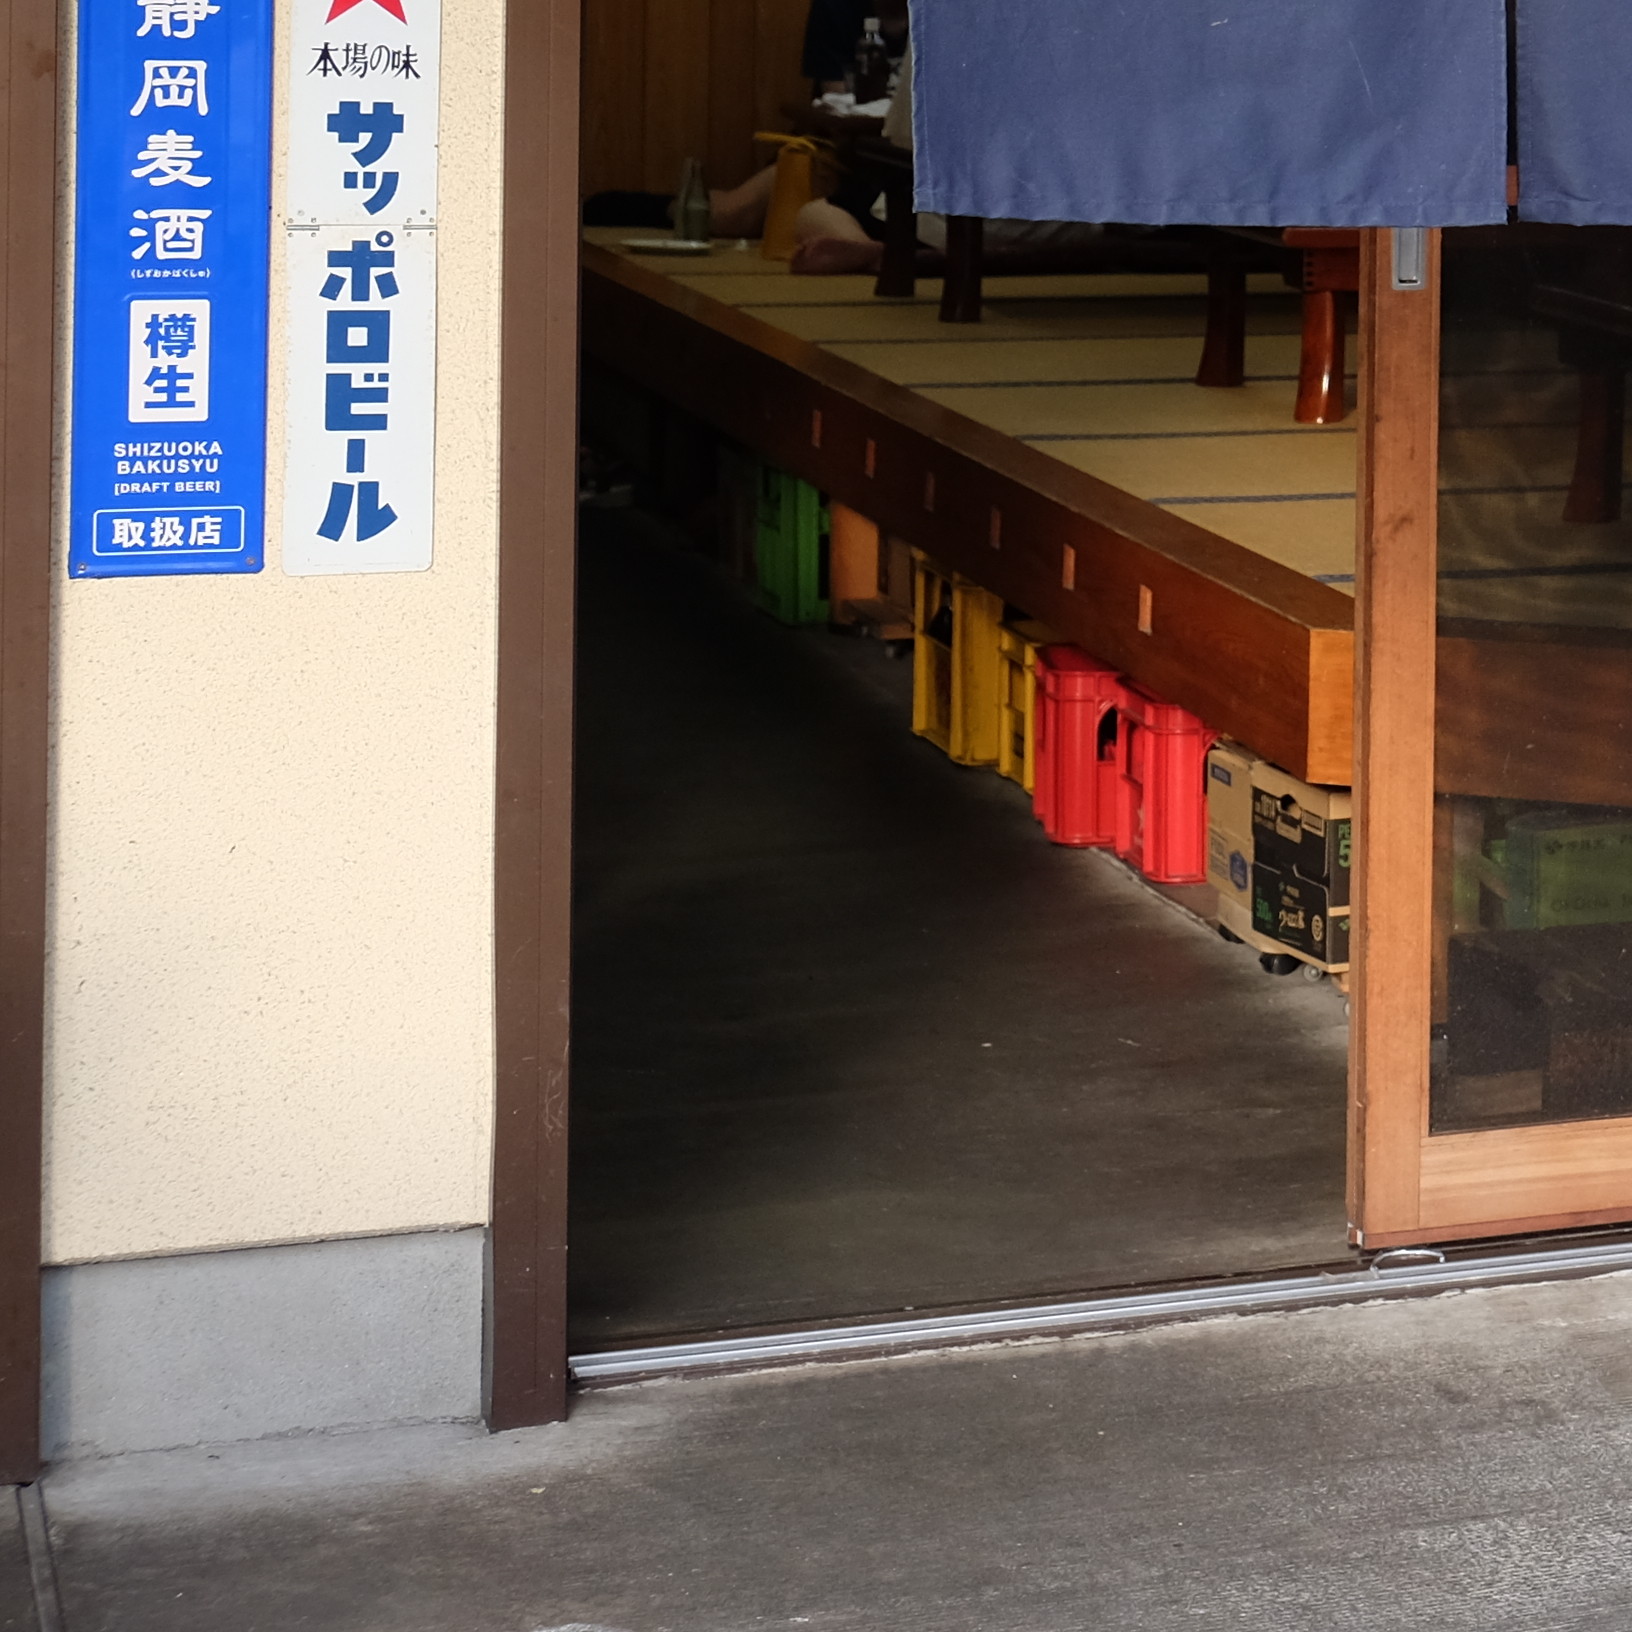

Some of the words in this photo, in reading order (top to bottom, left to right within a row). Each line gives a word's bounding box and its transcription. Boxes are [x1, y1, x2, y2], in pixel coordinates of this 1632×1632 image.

[306, 41, 422, 80] 本場の味
[316, 100, 405, 543] サッポロビール
[143, 312, 197, 410] 樽生
[113, 441, 223, 458] SHIZUOKA
[116, 458, 219, 475] BAKUSYU
[114, 481, 169, 496] [DRAFT
[174, 480, 221, 494] BEER]
[111, 515, 223, 549] 取扱店
